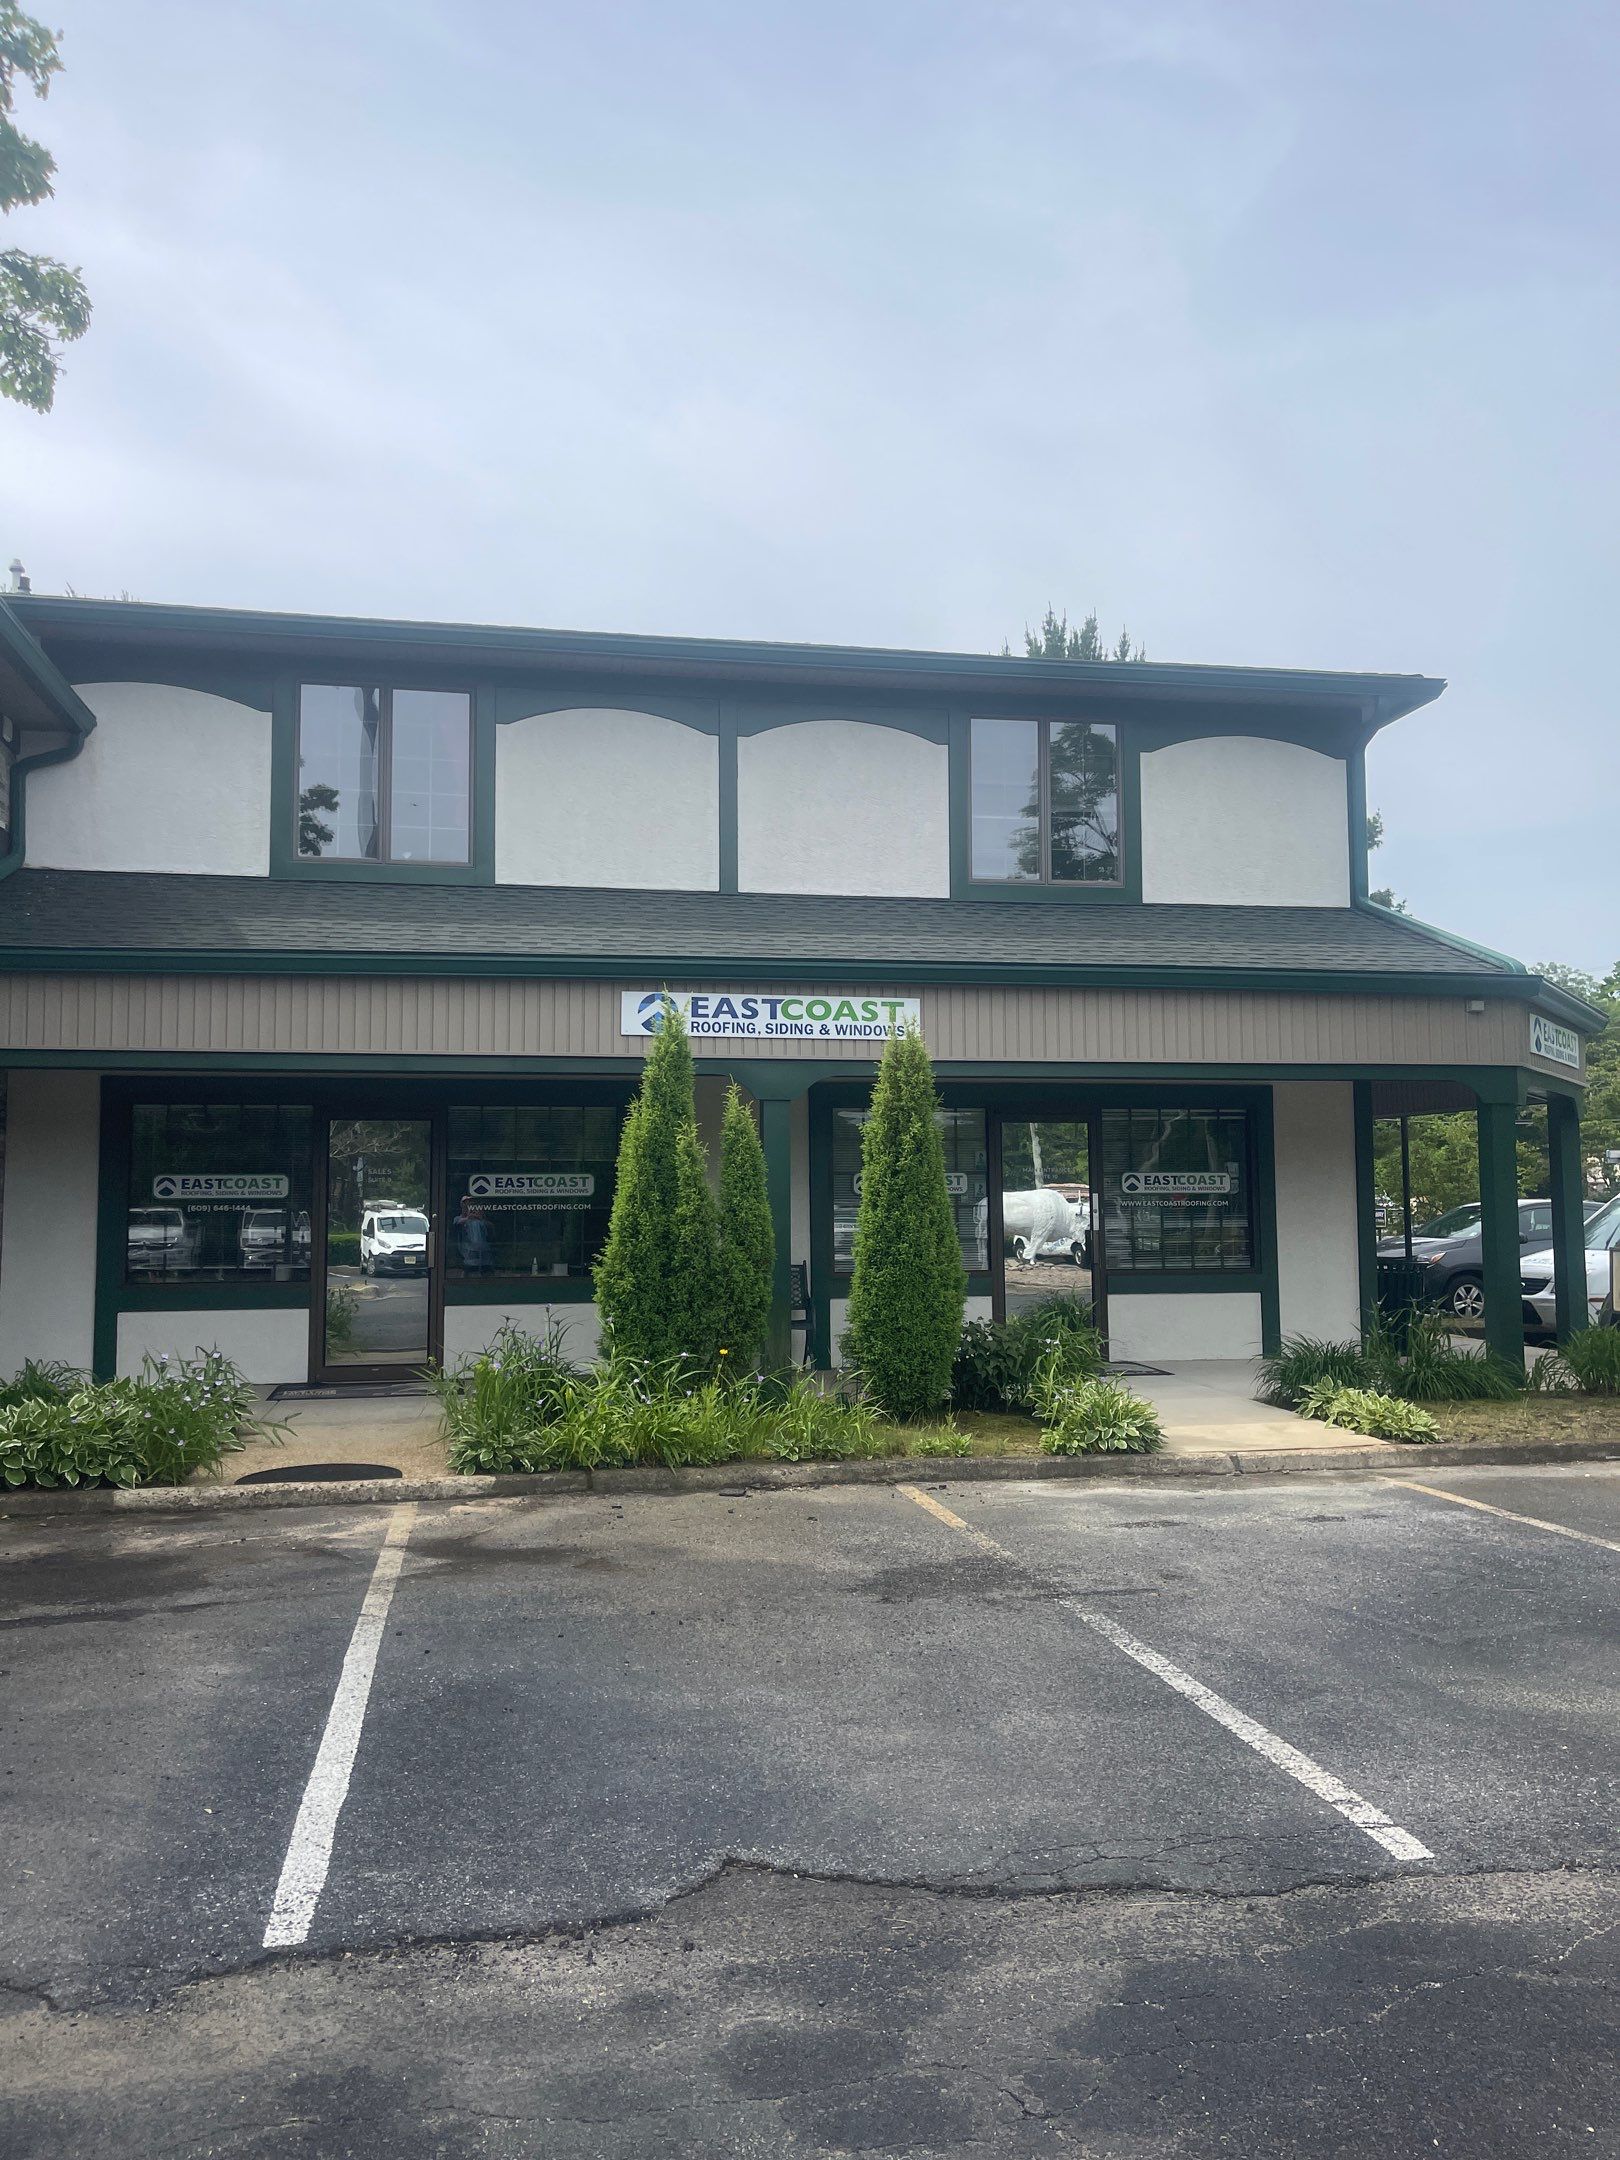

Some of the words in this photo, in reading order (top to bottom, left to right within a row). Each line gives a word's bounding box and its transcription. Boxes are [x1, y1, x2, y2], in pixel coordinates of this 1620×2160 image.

[691, 997, 905, 1022] EASTCOAST
[691, 1021, 761, 1036] ROOFING,
[765, 1023, 814, 1035] SIDING
[820, 1024, 830, 1035] &
[181, 1178, 284, 1190] EASTCOAST
[495, 1176, 590, 1188] EASTCOAST
[1144, 1175, 1227, 1186] EASTCOAST
[187, 1204, 211, 1212] (609)
[467, 1203, 592, 1211] WWW.EASTCOASTROOFING.COM
